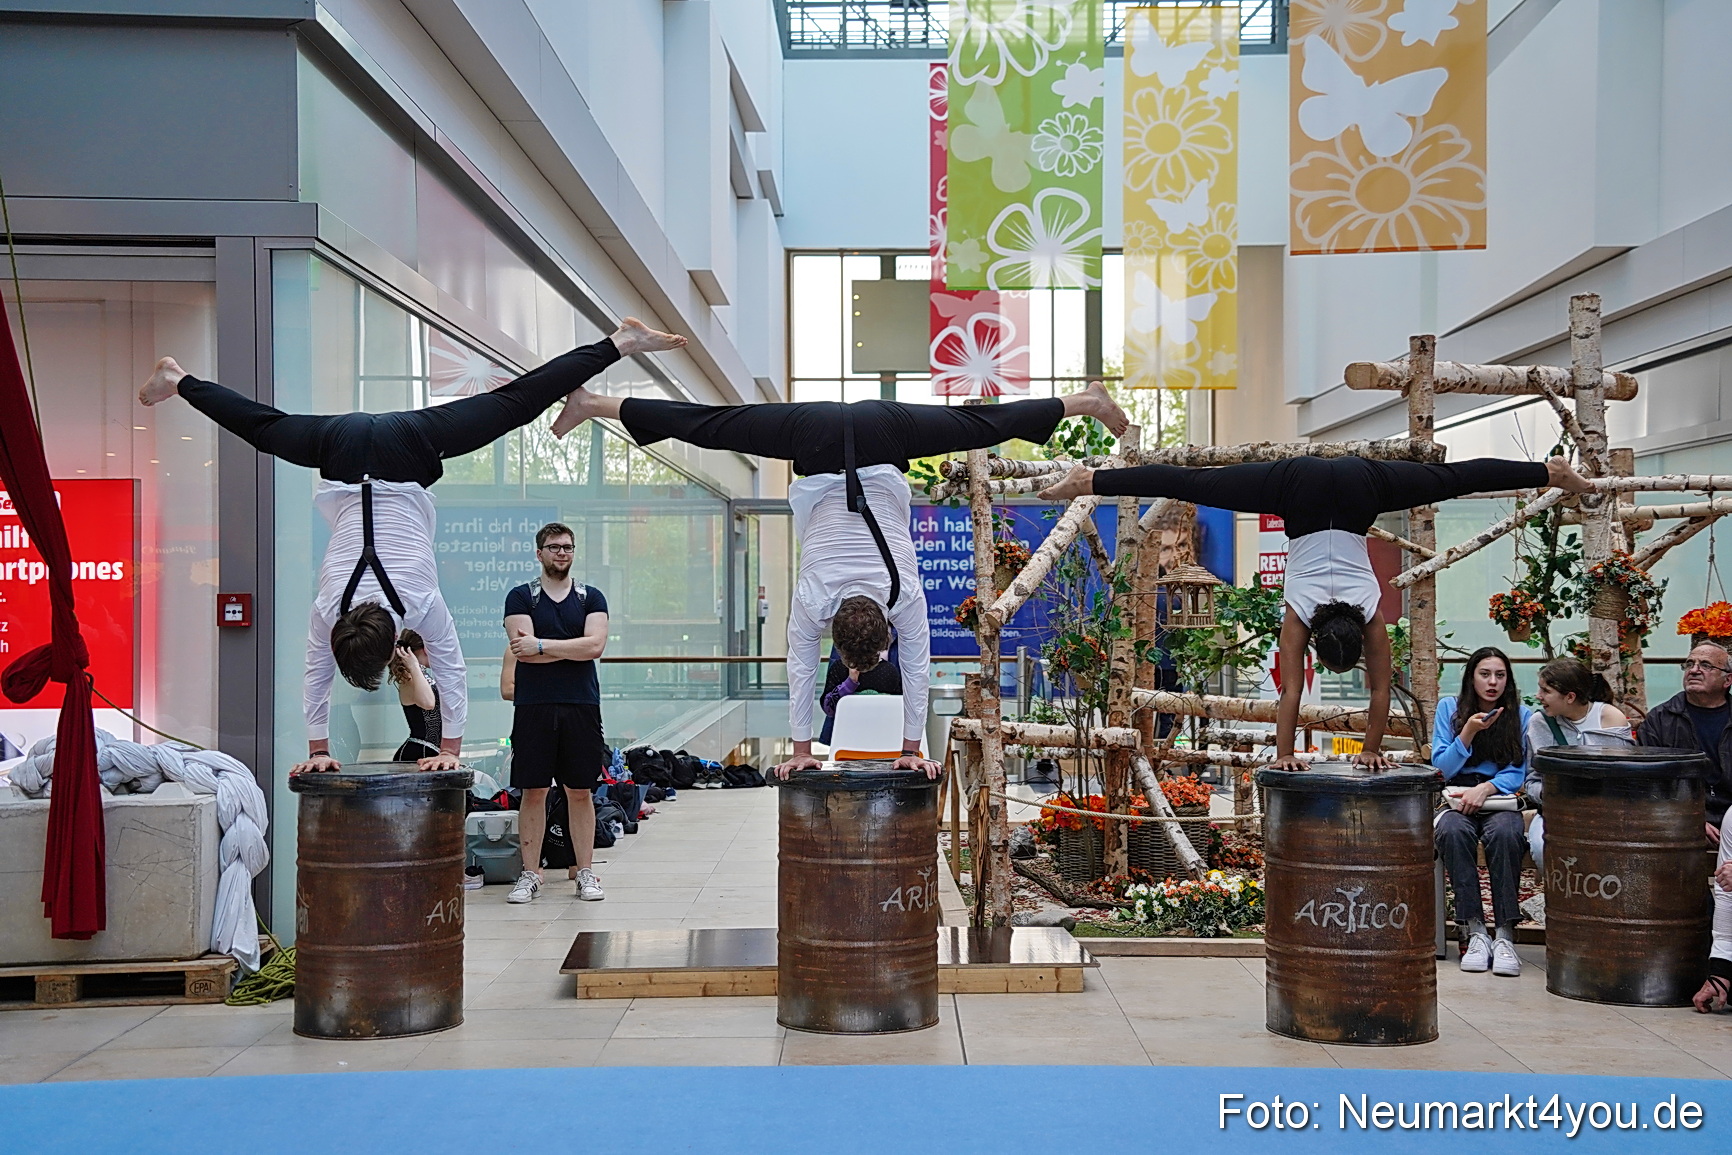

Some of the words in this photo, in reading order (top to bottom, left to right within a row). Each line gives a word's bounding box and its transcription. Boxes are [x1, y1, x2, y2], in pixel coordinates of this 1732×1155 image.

[913, 516, 938, 532] Ich
[914, 536, 945, 551] den
[1261, 555, 1286, 571] REW
[948, 576, 977, 590] We
[930, 605, 950, 613] HD+
